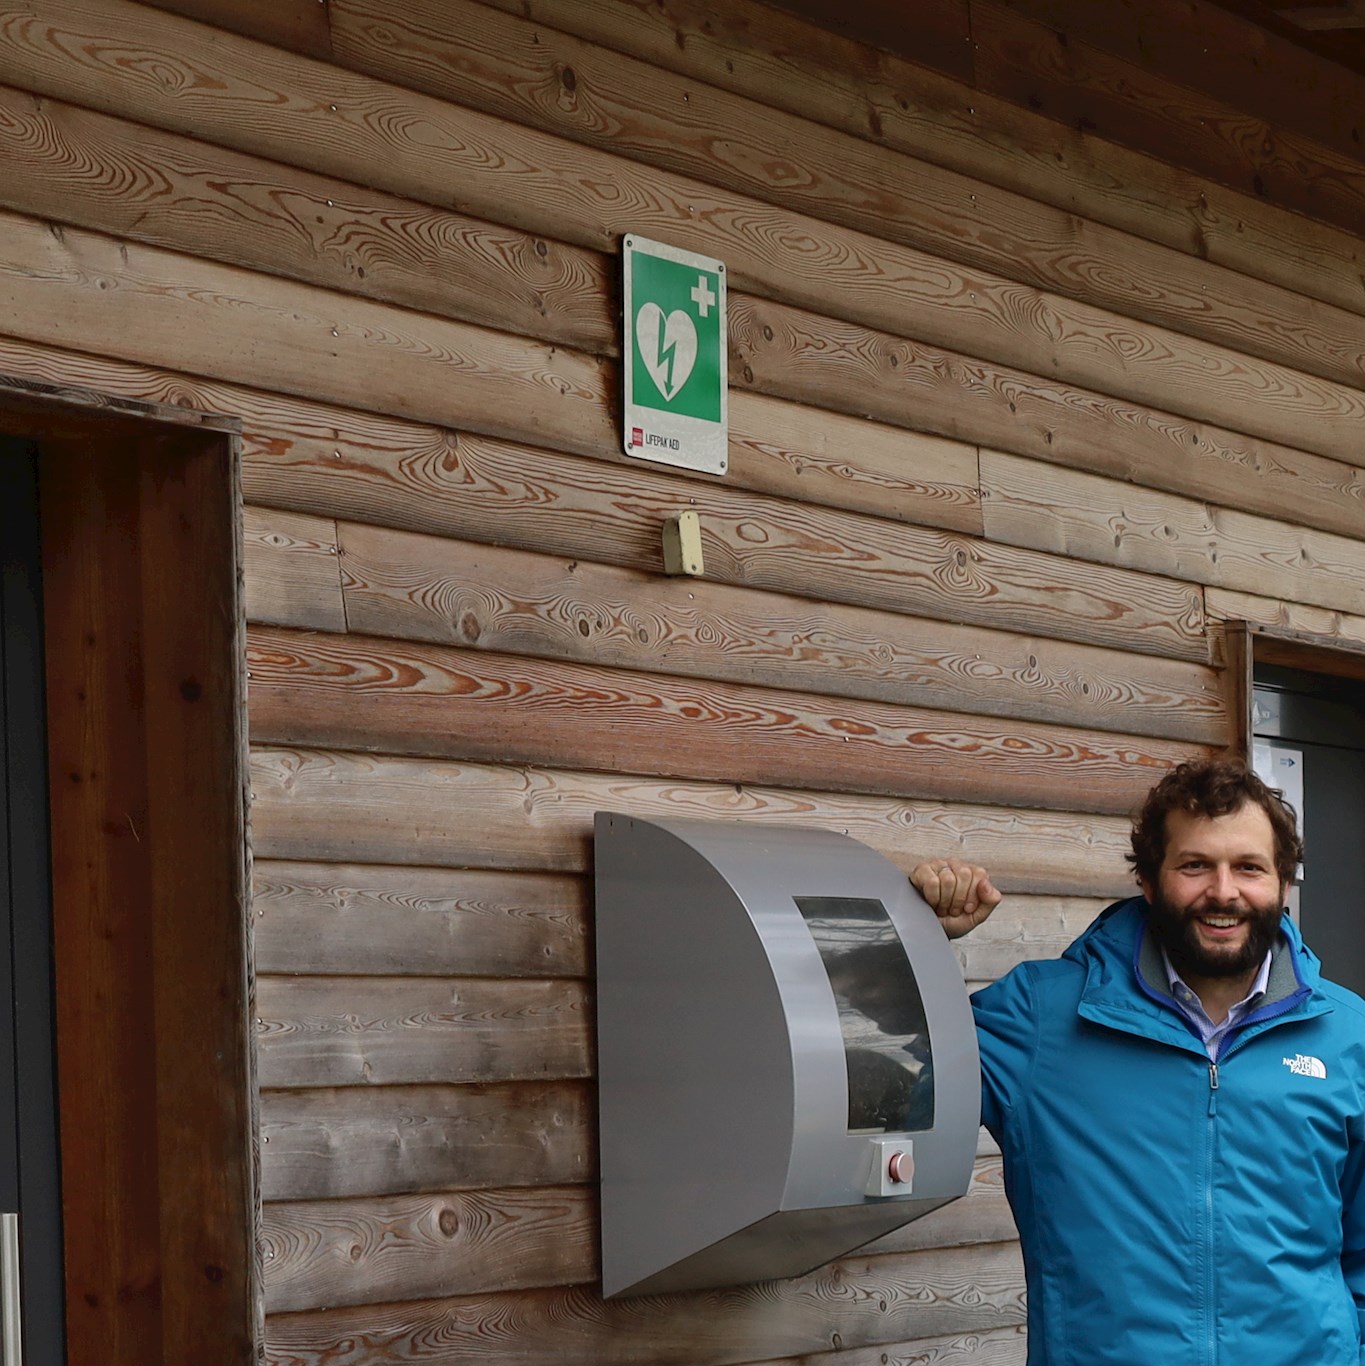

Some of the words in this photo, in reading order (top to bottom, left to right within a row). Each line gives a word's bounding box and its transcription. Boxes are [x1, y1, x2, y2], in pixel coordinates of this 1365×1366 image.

[645, 433, 668, 449] LIFEPAK
[669, 438, 680, 451] AED
[1282, 1057, 1311, 1071] NORTH
[1295, 1053, 1311, 1064] THE
[1290, 1066, 1311, 1077] FACE
